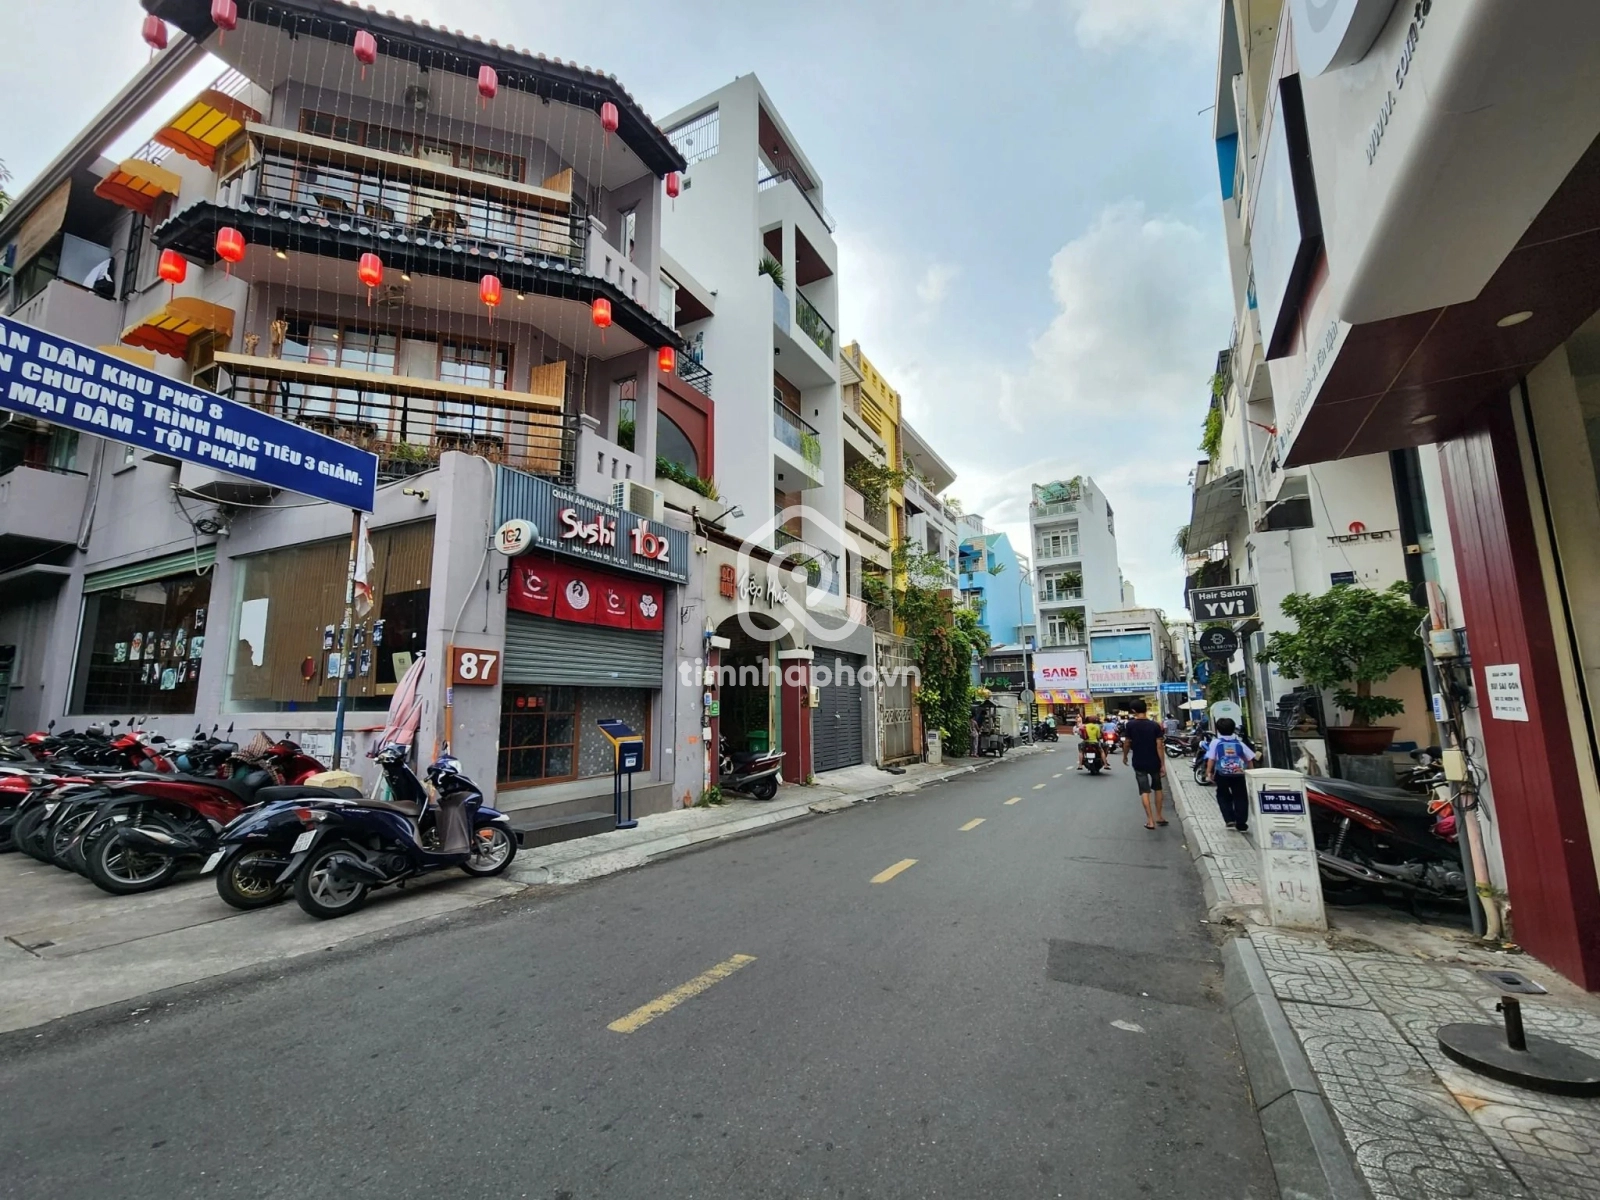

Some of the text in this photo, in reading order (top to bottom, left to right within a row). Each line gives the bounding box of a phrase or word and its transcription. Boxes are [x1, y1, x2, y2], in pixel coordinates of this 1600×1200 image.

[38, 341, 96, 376] DÂN
[101, 363, 154, 395] KHU
[158, 384, 208, 413] PHỐ
[208, 403, 223, 420] 8
[8, 381, 67, 414] MẠI
[73, 401, 134, 434] DÂM
[153, 425, 192, 452] TỘI
[197, 440, 257, 471] PHẠM
[21, 361, 135, 413] CHƯƠNG
[142, 400, 211, 437] TRÌNH
[214, 424, 260, 452] MỤC
[263, 441, 302, 466] TIÊU
[304, 455, 316, 471] 3
[558, 508, 670, 563] Sushi 102
[1327, 530, 1392, 544] TOPTEN
[1198, 589, 1248, 601] Hair Salon
[1204, 600, 1246, 617] YVi
[459, 652, 497, 680] 87
[1042, 667, 1078, 678] SANS
